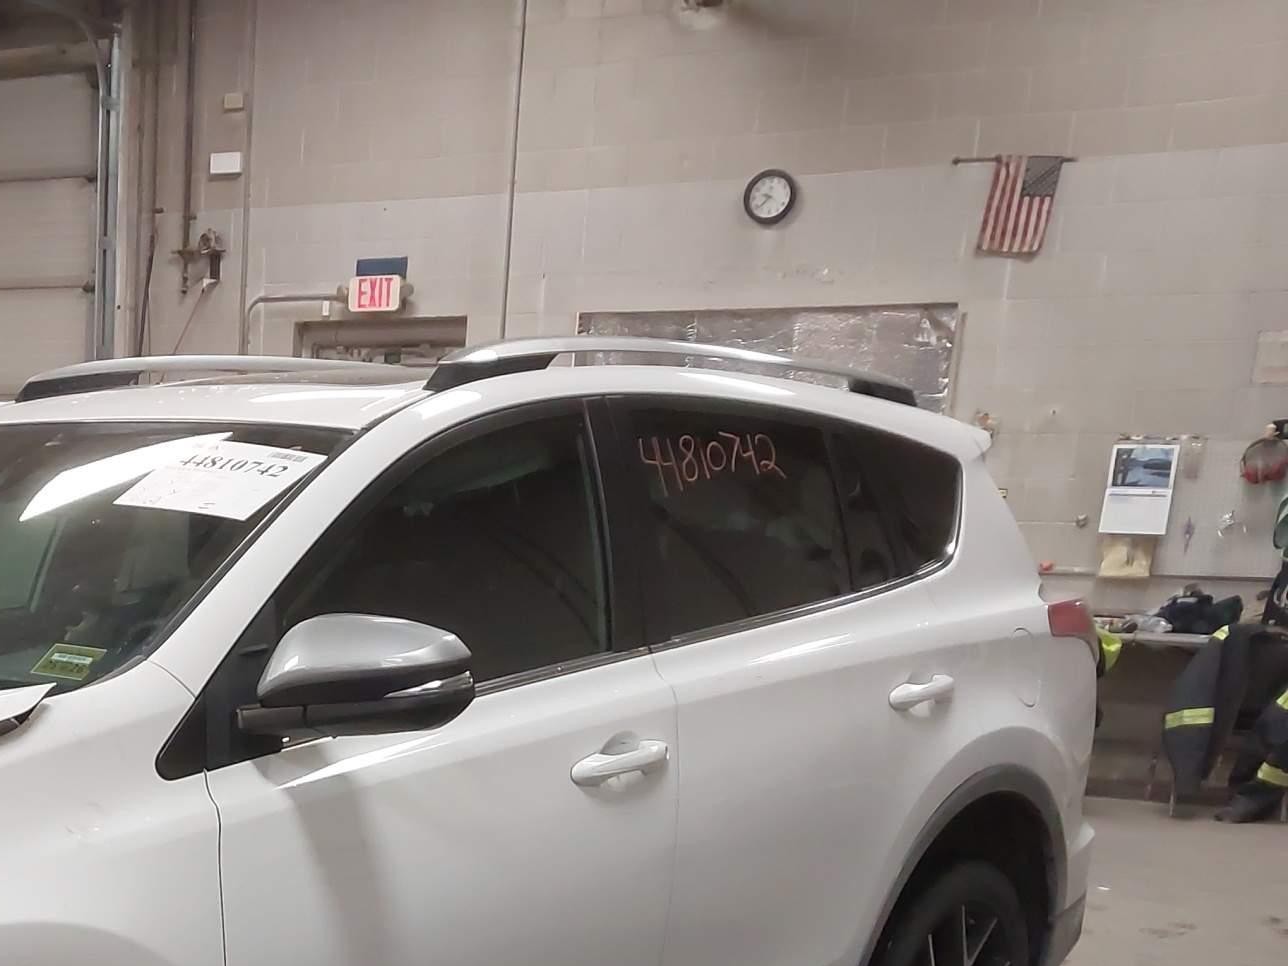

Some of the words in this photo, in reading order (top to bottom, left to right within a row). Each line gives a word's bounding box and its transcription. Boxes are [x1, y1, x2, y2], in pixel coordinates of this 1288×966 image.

[358, 277, 394, 308] EXIT
[180, 454, 288, 477] 44810742
[638, 430, 787, 497] 44810742
